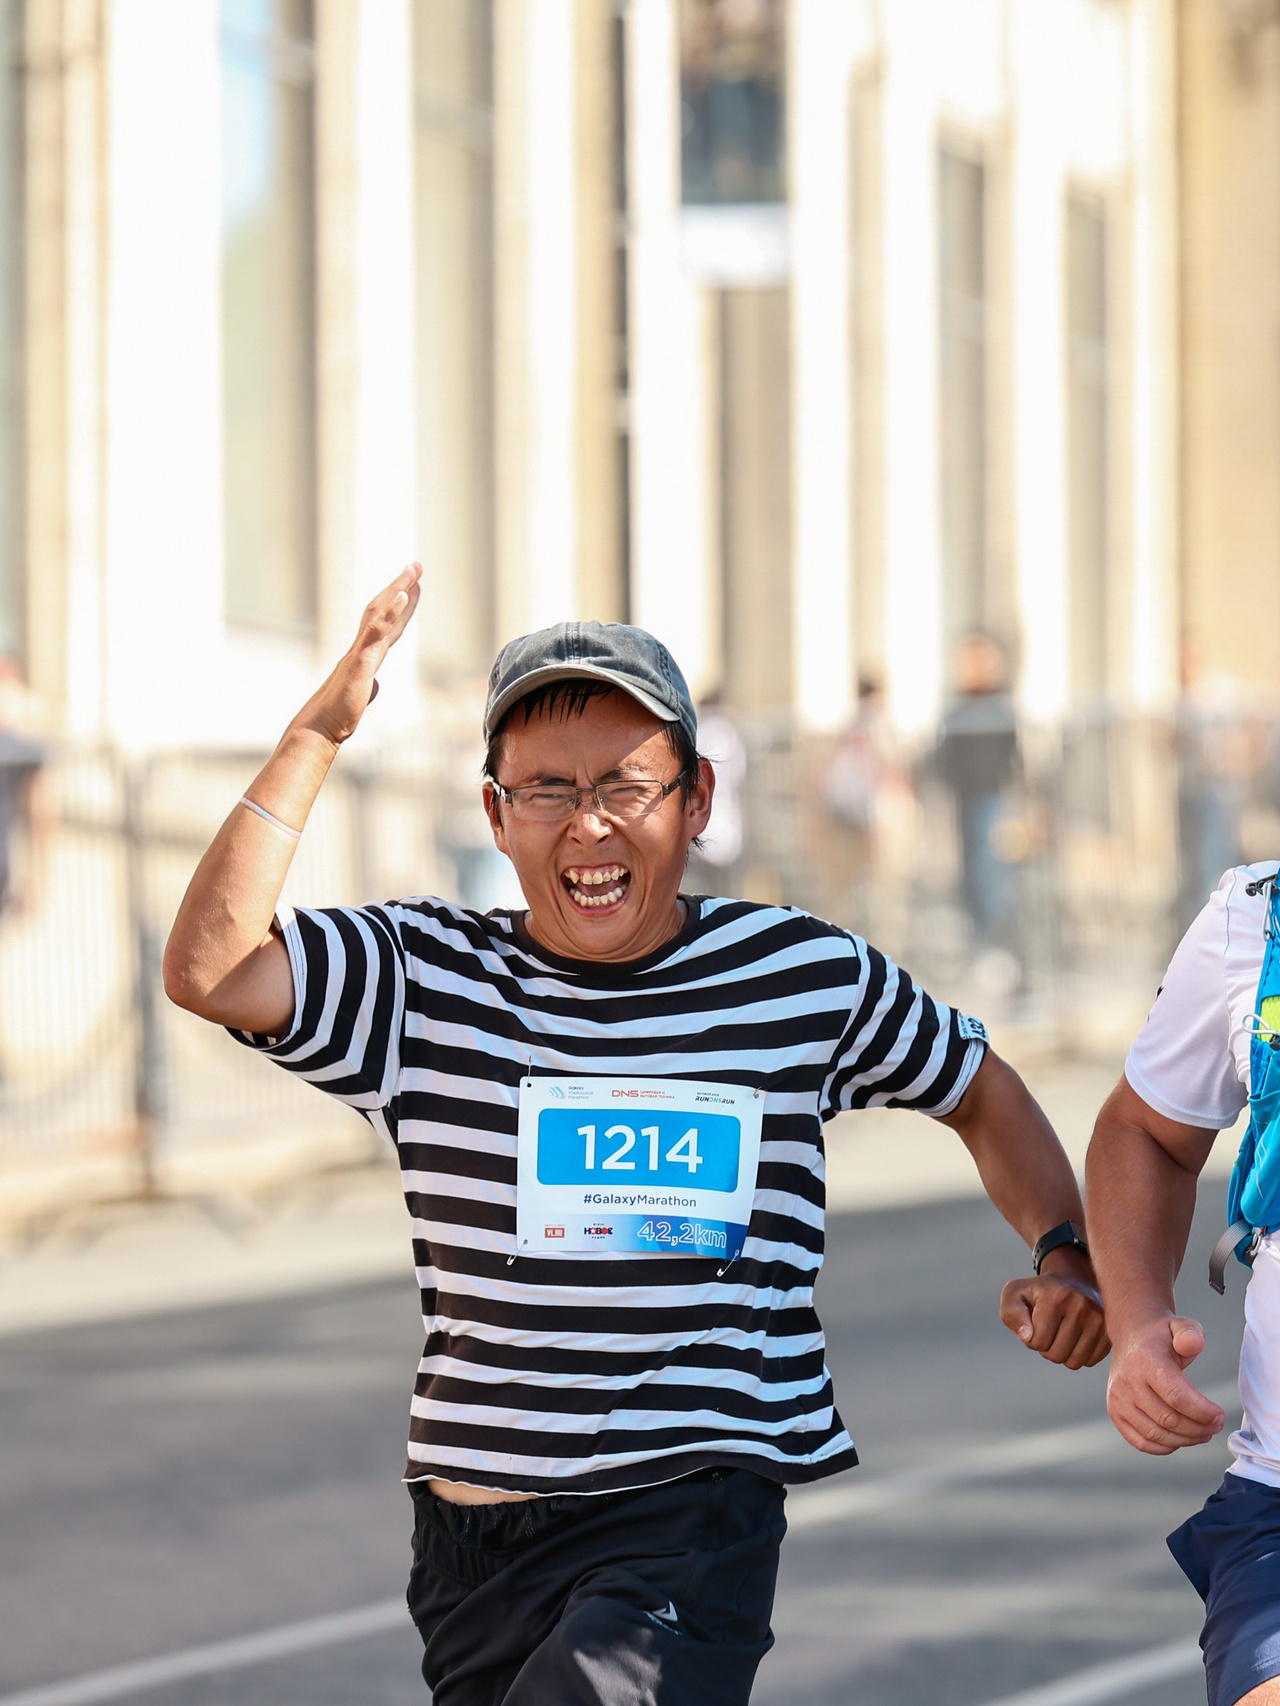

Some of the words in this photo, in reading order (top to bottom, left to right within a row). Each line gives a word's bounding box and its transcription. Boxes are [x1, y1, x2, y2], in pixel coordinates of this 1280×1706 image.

[611, 1090, 639, 1098] DNS
[577, 1124, 703, 1173] 1214
[584, 1194, 697, 1207] #GalaxyMarathon
[637, 1220, 727, 1248] 42,2km
